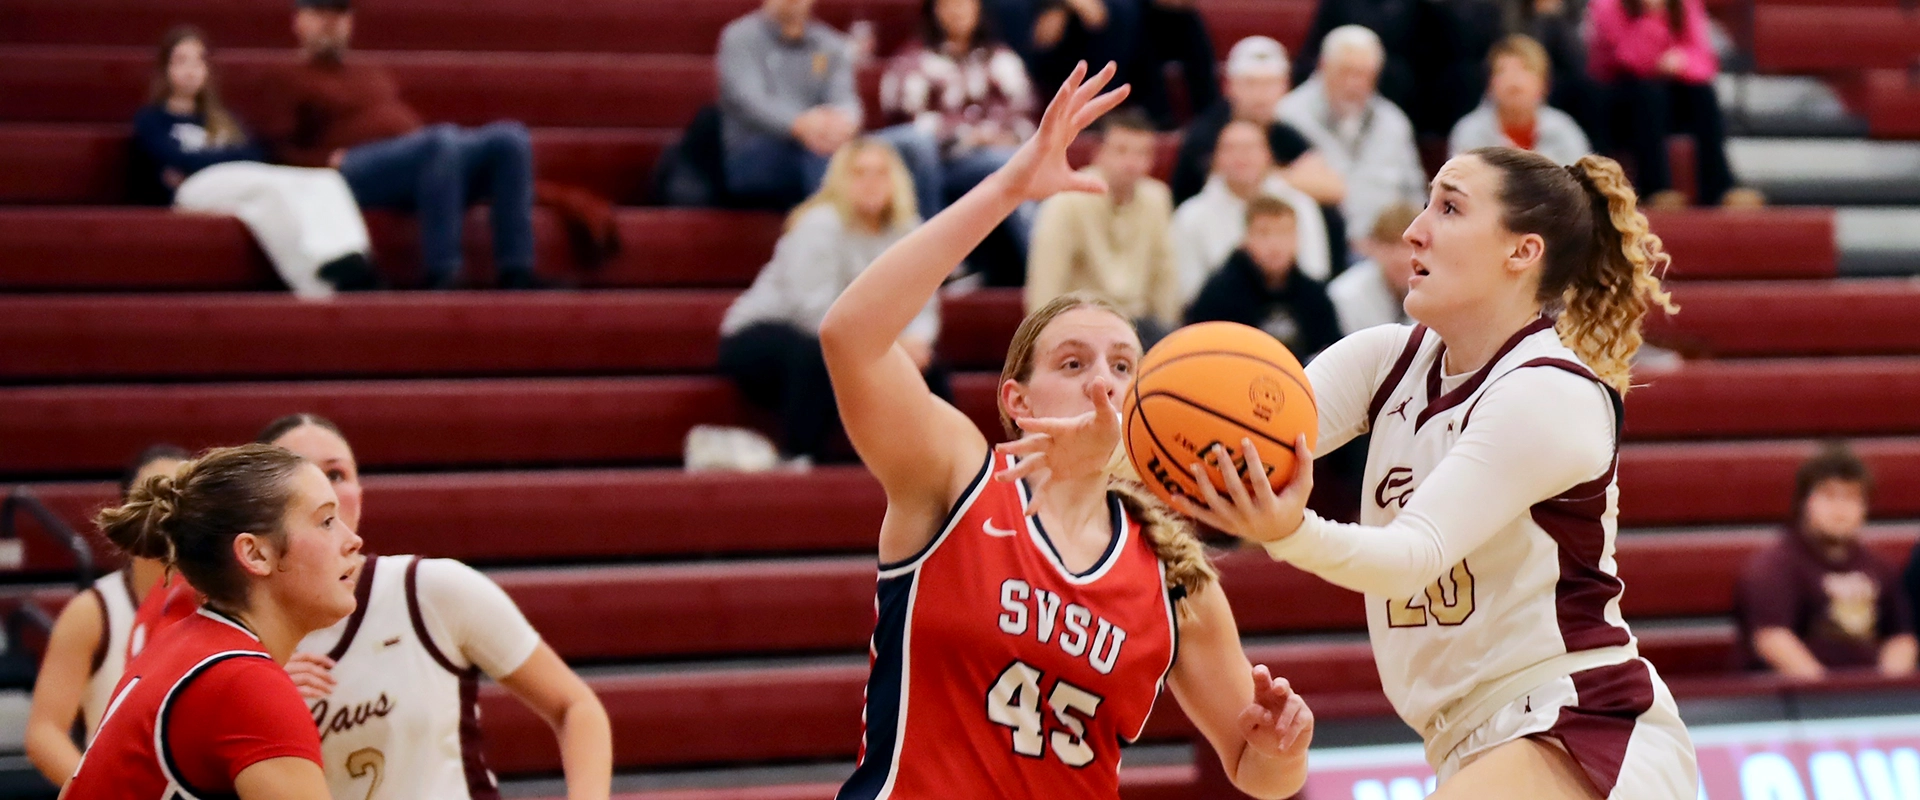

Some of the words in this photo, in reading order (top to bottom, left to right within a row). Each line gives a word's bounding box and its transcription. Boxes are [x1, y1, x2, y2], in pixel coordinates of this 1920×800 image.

[998, 578, 1127, 675] SVSU
[987, 657, 1105, 769] 45
[345, 747, 385, 800] 2
